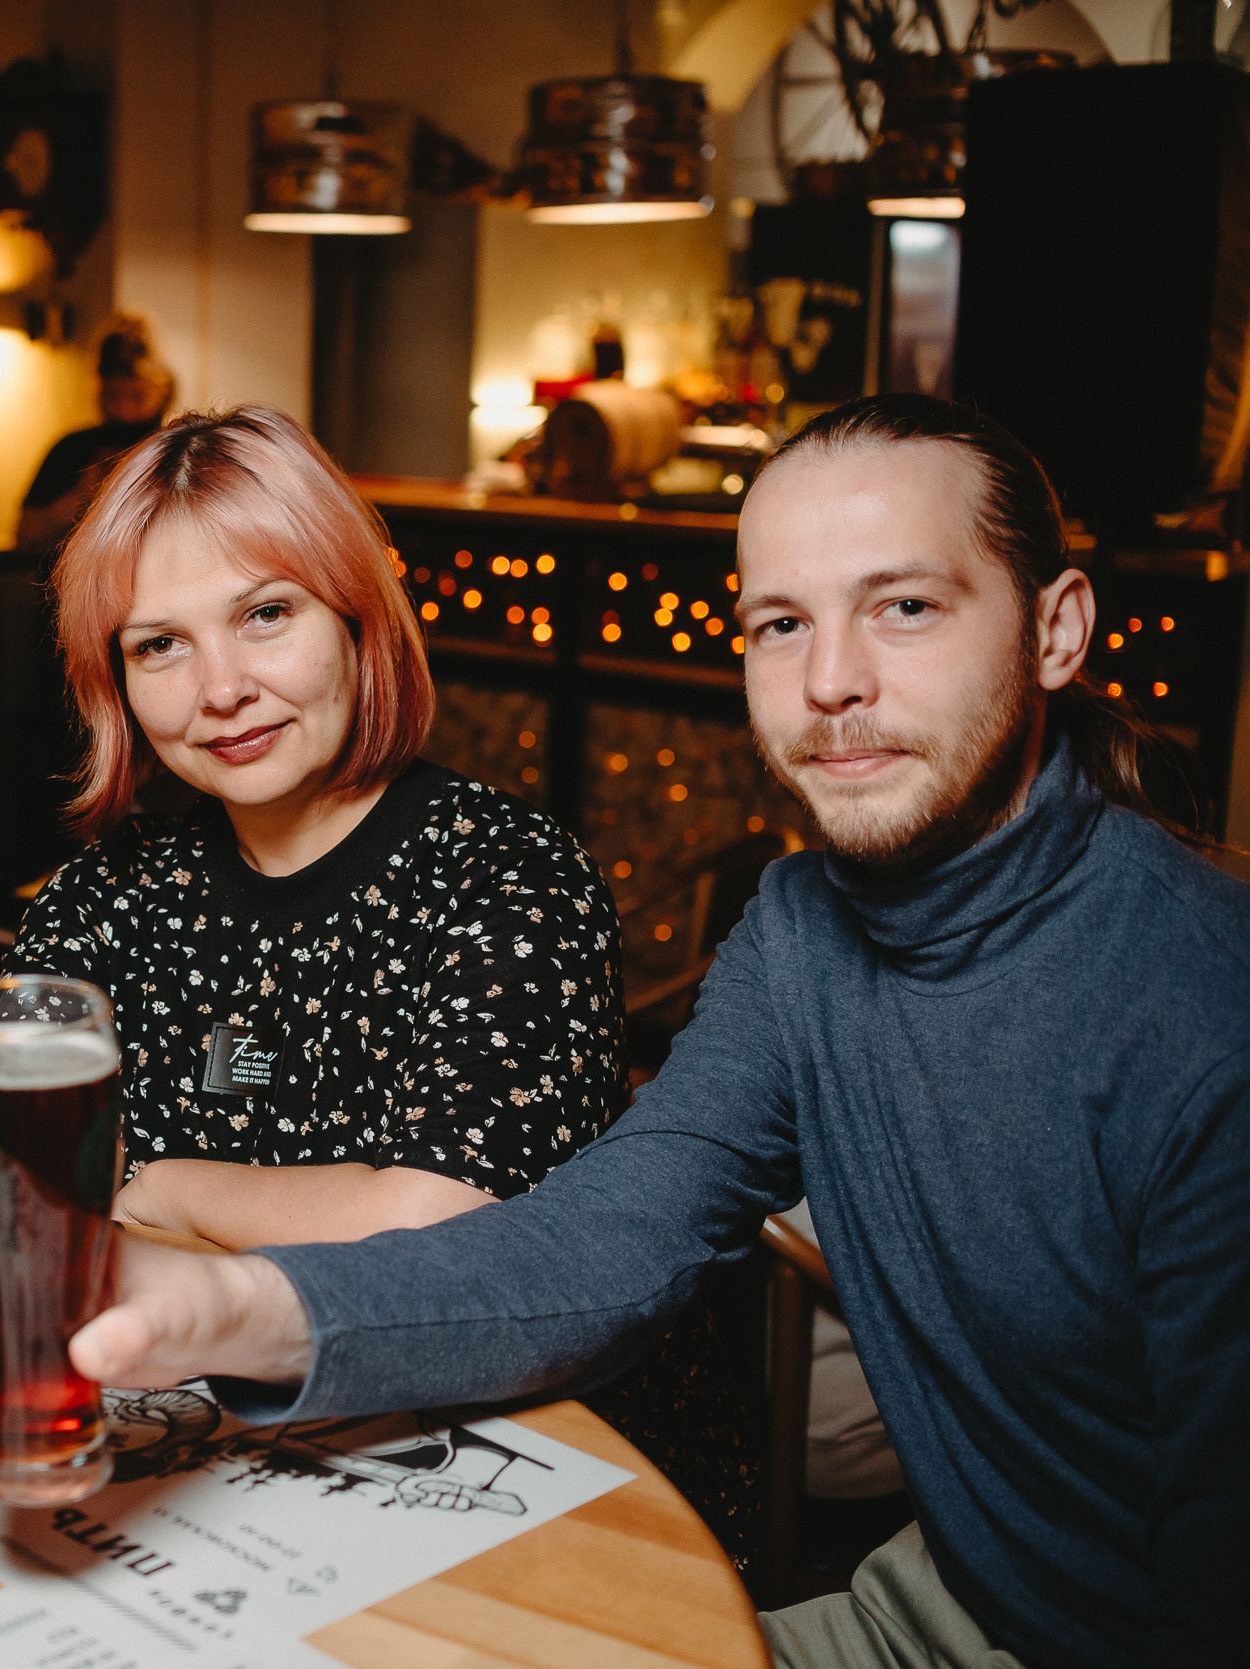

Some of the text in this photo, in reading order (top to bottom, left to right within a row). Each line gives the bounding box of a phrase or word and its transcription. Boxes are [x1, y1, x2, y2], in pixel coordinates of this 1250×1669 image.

[237, 1060, 251, 1068] STAY
[232, 1067, 249, 1076] WORK
[249, 1069, 263, 1077] HARD
[231, 1075, 249, 1084] MAKE
[52, 1508, 174, 1576] ПИТЬ
